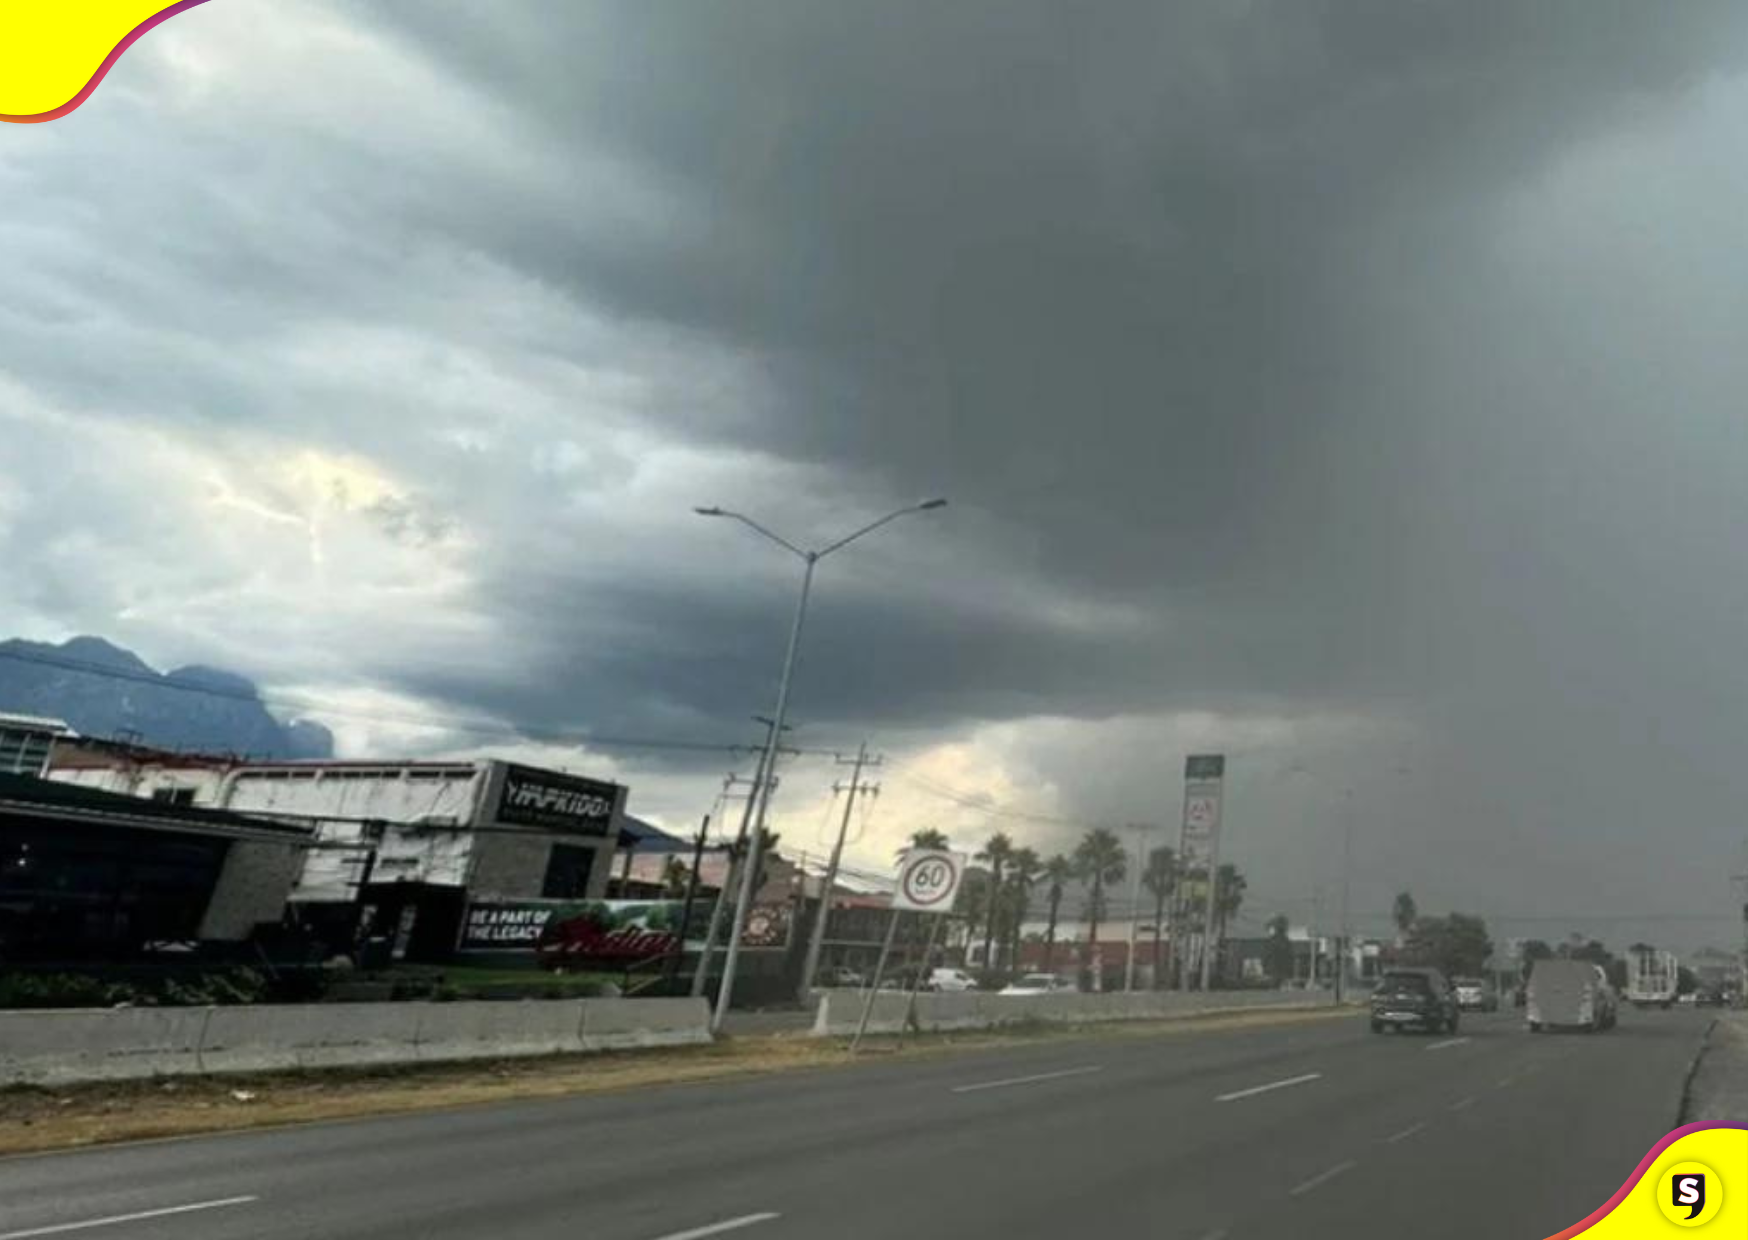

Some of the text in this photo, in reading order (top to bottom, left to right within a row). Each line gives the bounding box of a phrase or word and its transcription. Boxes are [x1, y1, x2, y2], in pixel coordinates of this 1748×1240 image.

[915, 865, 945, 888] 60
[500, 910, 533, 924] PART
[533, 910, 553, 924] OF
[467, 925, 544, 940] THE LEGACY
